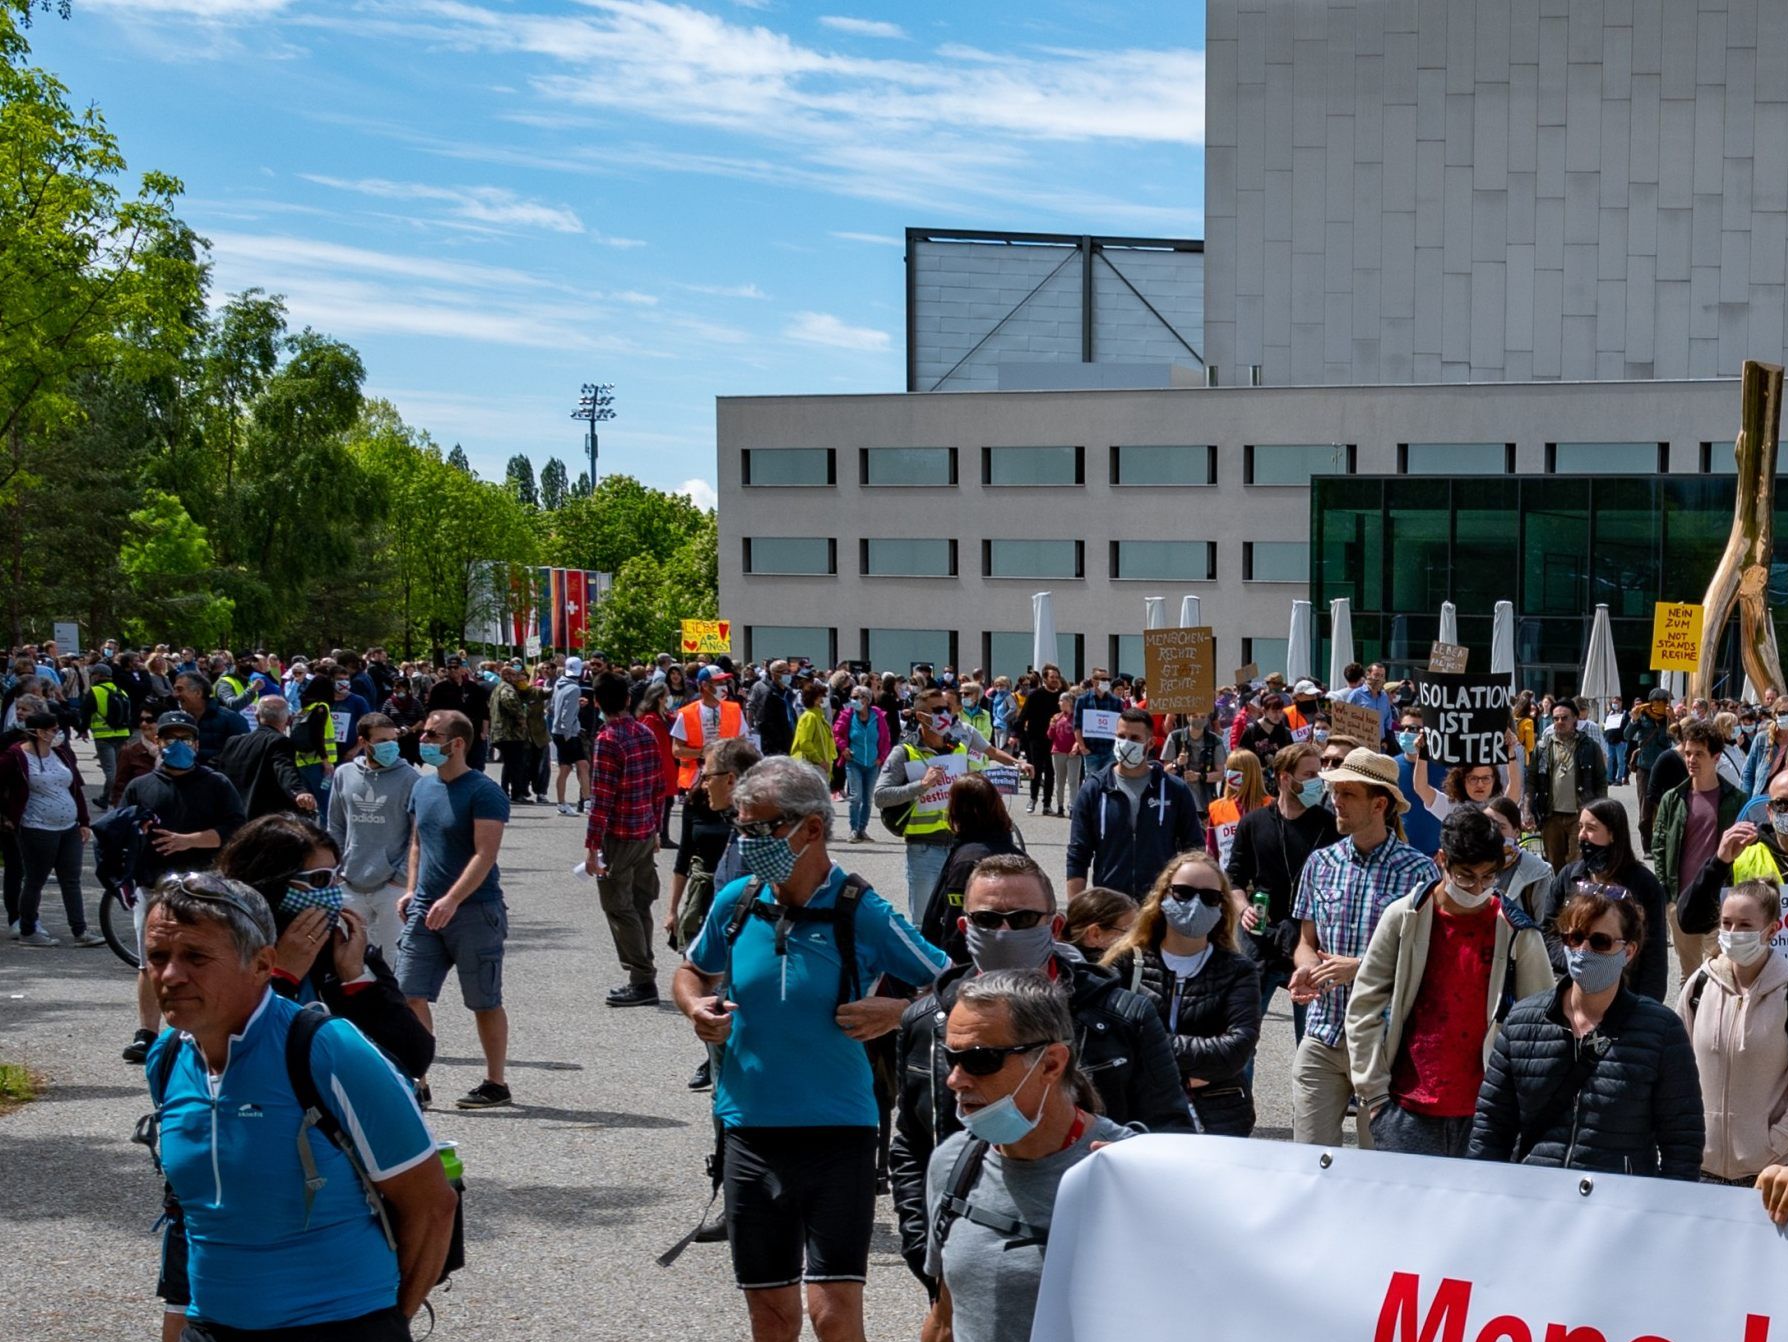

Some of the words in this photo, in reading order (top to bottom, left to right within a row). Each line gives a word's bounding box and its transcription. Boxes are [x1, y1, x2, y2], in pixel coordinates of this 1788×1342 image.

[1665, 618, 1690, 629] ZUM
[1668, 632, 1688, 640] NOT
[1656, 640, 1696, 651] STANDS
[1661, 650, 1697, 661] REGIME
[1420, 682, 1512, 709] ISOLATION
[1440, 712, 1474, 734] IST
[351, 813, 386, 825] adidas
